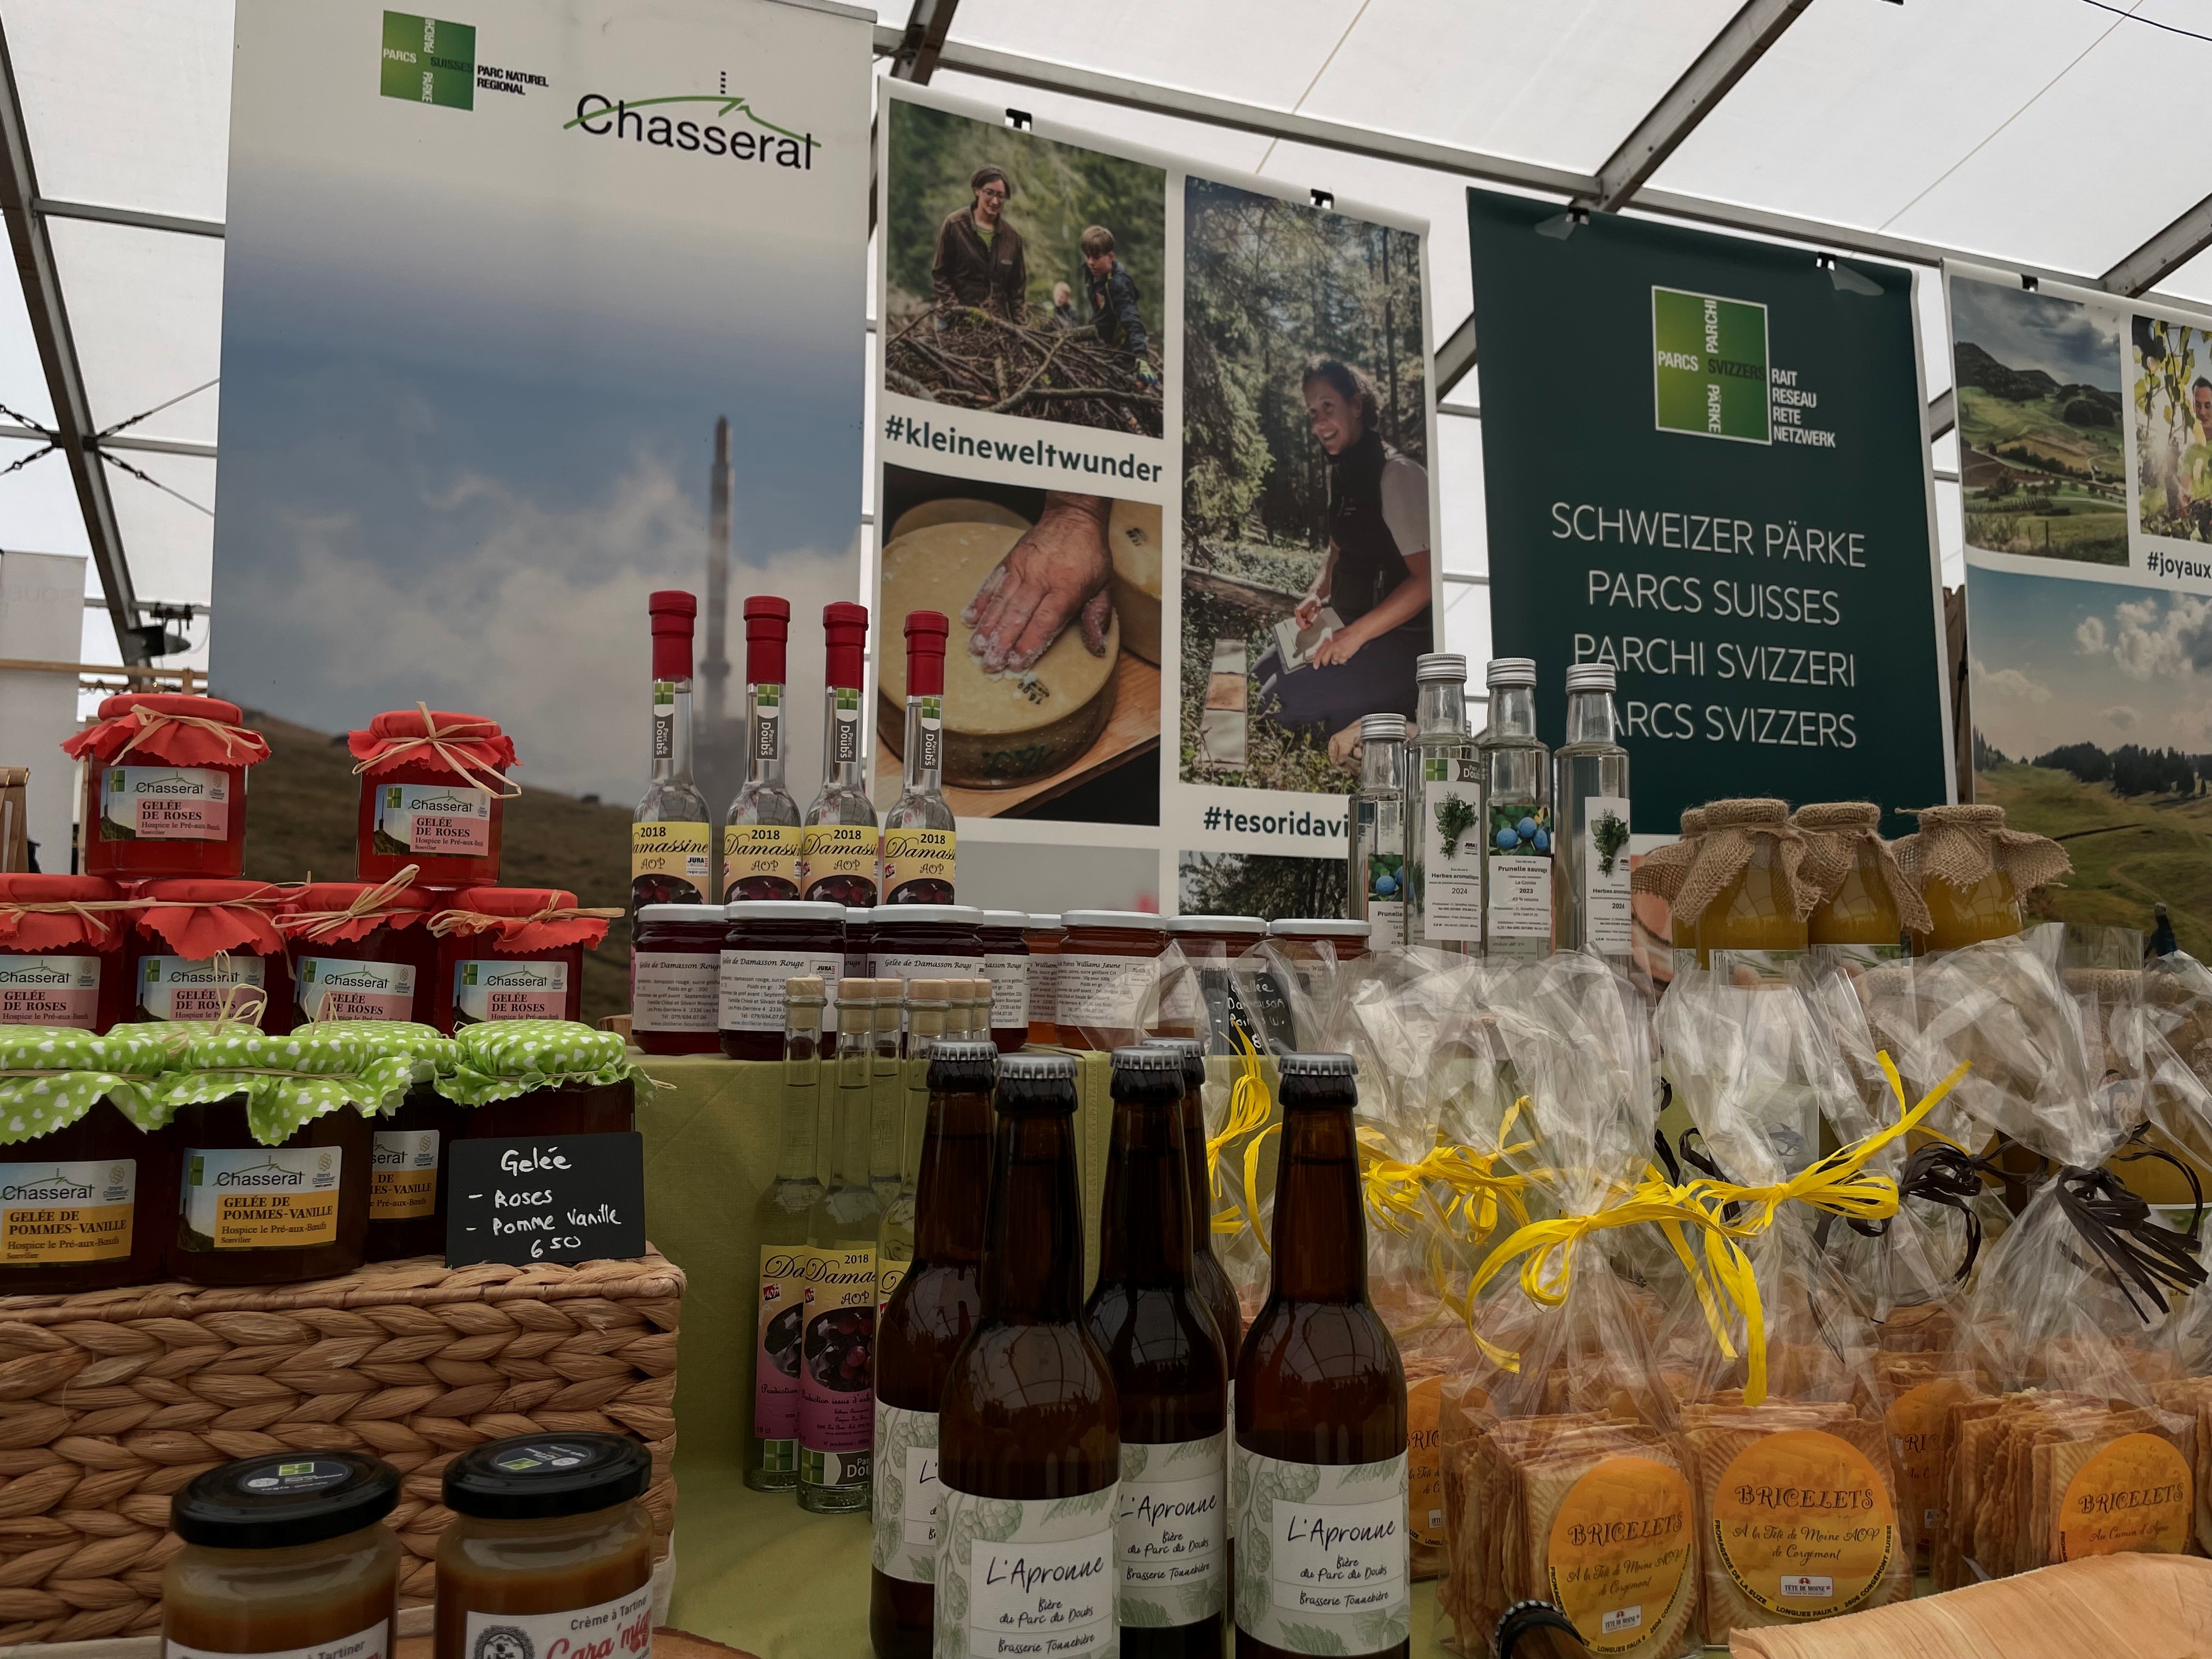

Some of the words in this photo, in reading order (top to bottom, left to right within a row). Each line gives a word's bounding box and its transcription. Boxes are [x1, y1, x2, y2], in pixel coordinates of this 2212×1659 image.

[383, 48, 416, 63] PARCS
[431, 57, 474, 72] SUISSES
[477, 64, 503, 78] PARC
[506, 70, 549, 87] NATUREL
[477, 77, 526, 96] REGIONAL
[577, 93, 812, 170] Chasseral
[1705, 299, 1719, 354] PARCHI
[1658, 351, 1699, 371] PARCS
[1771, 368, 1797, 387] RAIT
[1772, 388, 1817, 408] RESEAU
[1707, 383, 1721, 433] PÄRKE
[1773, 406, 1801, 425] RETE
[1774, 425, 1836, 448] NETZWERK
[884, 415, 1163, 483] #kleineweltwunder
[1551, 502, 1754, 556] SCHWEIZER
[1765, 519, 1866, 568] PÄRKE
[2147, 551, 2211, 579] #joyaux
[1589, 569, 1702, 614] PARCS
[1713, 580, 1840, 626] SUISSES
[1574, 634, 1704, 677] PARCHI
[1717, 642, 1855, 687] SVIZZERI
[1705, 704, 1857, 749] SVIZZERS
[656, 721, 665, 755] Doubs
[761, 722, 771, 756] Doubs
[840, 725, 850, 758] Doubs
[925, 733, 934, 766] Doubs
[137, 782, 204, 794] Chasseral
[143, 800, 182, 810] GELÉE
[411, 799, 471, 812] Chasseral
[142, 811, 159, 820] DE
[164, 811, 202, 820] ROSES
[417, 817, 452, 827] GELÉE
[1203, 806, 1348, 838] #tesoridavi
[416, 827, 431, 836] DE
[436, 828, 470, 837] ROSES
[641, 827, 666, 837] 2018
[752, 830, 780, 839] 2018
[833, 830, 861, 840] 2018
[921, 834, 945, 844] 2018
[641, 857, 665, 870] AOP
[751, 860, 778, 871] AOP
[833, 859, 860, 871] AOP
[919, 864, 944, 874] AOP
[780, 960, 804, 969] Rouge
[885, 959, 901, 967] Gelée
[0, 972, 69, 983] Chasseral
[171, 972, 238, 983] Chasseral
[325, 974, 387, 989] Chasseral
[487, 975, 546, 986] Chasseral
[4, 990, 46, 1001] GELÉE
[177, 989, 216, 1000] GELÉE
[329, 993, 365, 1003] GELÉE
[492, 992, 527, 1002] GELÉE
[3, 1002, 21, 1011] DE
[26, 1002, 66, 1011] ROSES
[176, 1001, 192, 1009] DE
[347, 1005, 383, 1015] ROSES
[492, 1003, 507, 1012] DE
[500, 1146, 572, 1177] Gelée
[217, 1171, 302, 1186] Chasseral
[377, 1174, 394, 1183] DE
[3, 1184, 92, 1200] Chasseral
[494, 1188, 553, 1209] Roses
[224, 1195, 267, 1207] GELÉE
[271, 1197, 290, 1206] DE
[10, 1210, 55, 1222] GELÉE
[60, 1211, 80, 1221] DE
[223, 1205, 333, 1220] POMMES-VANILLE
[493, 1212, 556, 1236] Pomme
[566, 1203, 623, 1228] Vanille
[9, 1220, 127, 1235] POMMES-VANILLE
[222, 1226, 258, 1236] Hospice
[270, 1221, 326, 1233] Pré-aux-Bœufs
[8, 1241, 45, 1251] Hospice
[844, 1254, 868, 1264] 2018
[840, 1290, 870, 1305] AOP
[761, 1383, 798, 1394] Production
[1734, 1483, 1874, 1509] BRICELETS
[2078, 1482, 2185, 1514] BRICELETS
[1288, 1515, 1396, 1551] L'Apronne
[1567, 1511, 1683, 1547] BRICELETS
[1801, 1526, 1839, 1542] Moine
[1843, 1527, 1880, 1542] AOP
[1163, 1530, 1183, 1544] Bière
[1144, 1543, 1169, 1557] Parc
[1188, 1537, 1209, 1552] Doubs
[1336, 1554, 1359, 1569] Bière
[1623, 1560, 1652, 1573] Moine
[1714, 1519, 1734, 1570] FROMAGERIE
[1748, 1589, 1767, 1605] SUZE
[1776, 1606, 1811, 1617] LONGUES
[986, 1556, 1104, 1594] L'Apronne
[1126, 1566, 1166, 1581] Brasserie
[1169, 1562, 1210, 1581] Tonnebière
[1300, 1568, 1314, 1578] du
[1317, 1567, 1344, 1582] Parc
[1347, 1569, 1361, 1579] du
[1364, 1565, 1387, 1580] Doubs
[1038, 1596, 1063, 1612] Bière
[1300, 1590, 1341, 1606] Brasserie
[1344, 1591, 1389, 1607] Tonnebière
[571, 1614, 608, 1630] Crème
[1000, 1613, 1014, 1624] du
[1017, 1611, 1047, 1628] Parc
[1050, 1611, 1065, 1623] du
[1069, 1605, 1093, 1623] Doubs
[998, 1637, 1042, 1654] Brasserie
[1045, 1633, 1095, 1654] Tonnebière
